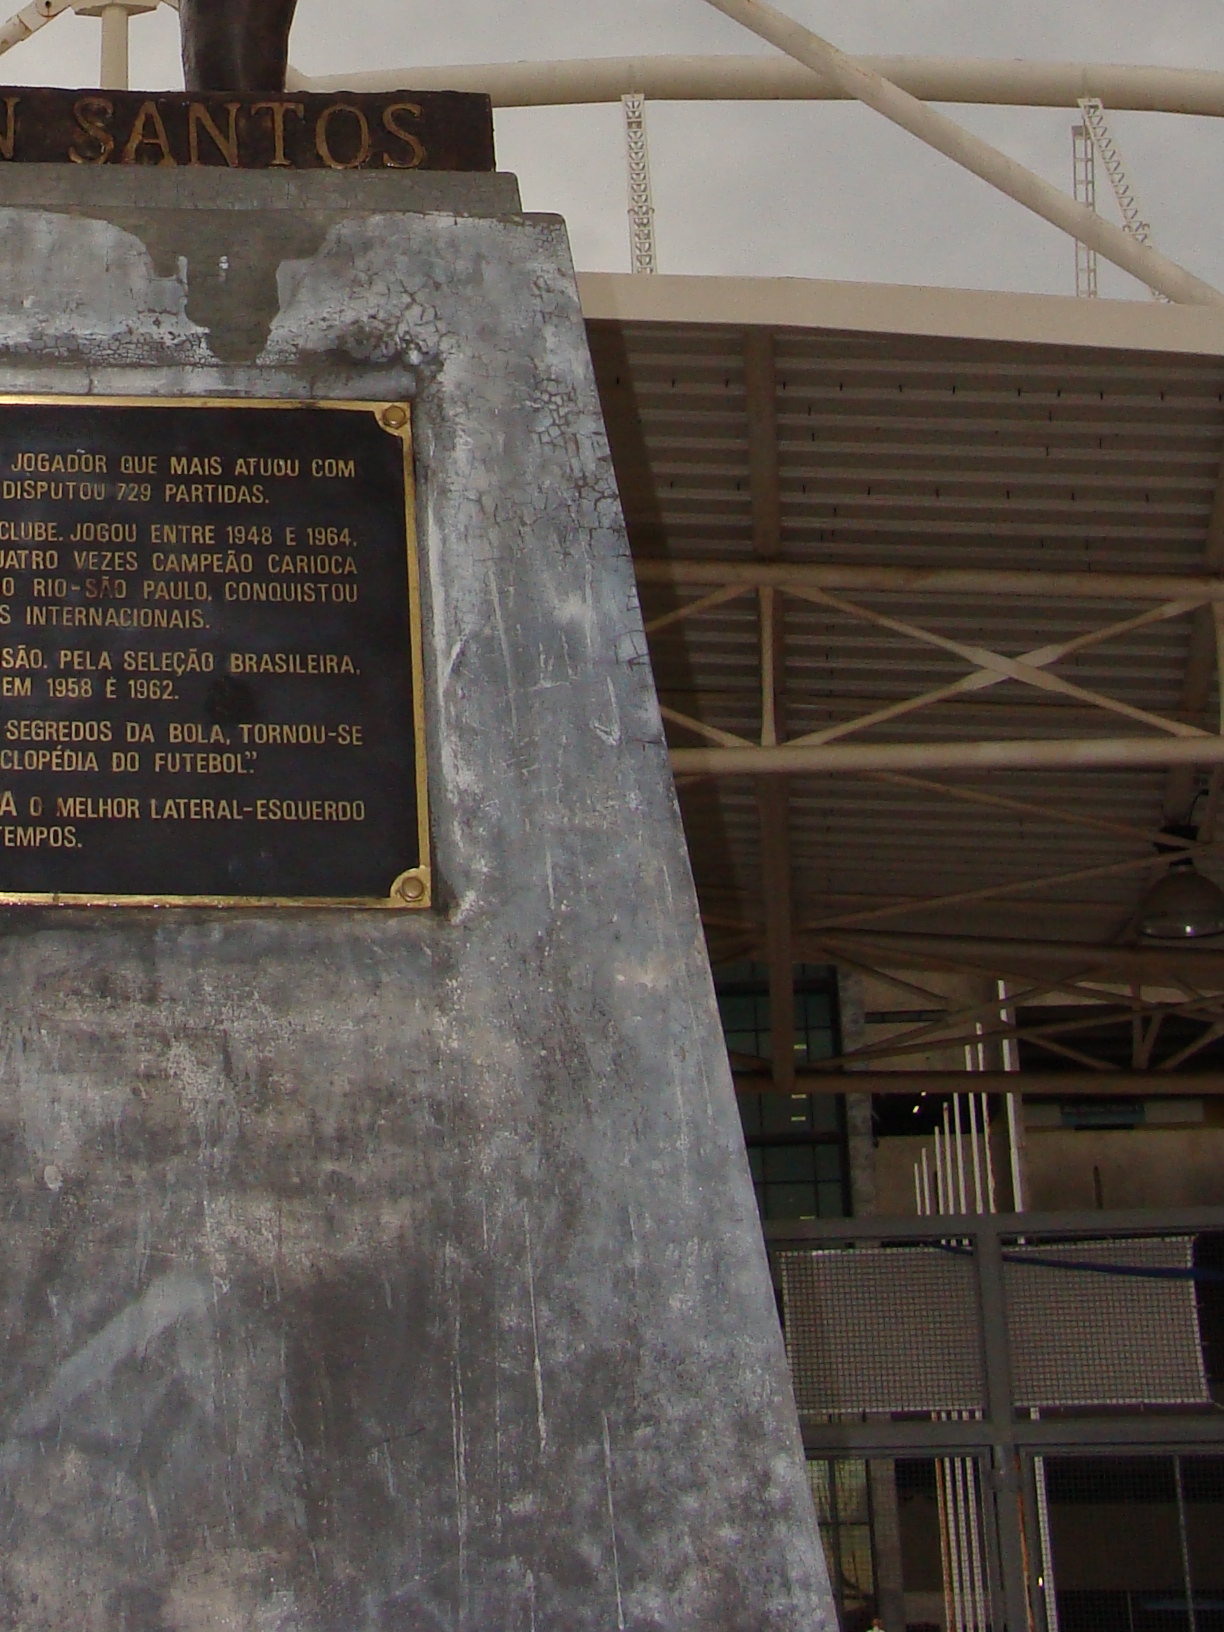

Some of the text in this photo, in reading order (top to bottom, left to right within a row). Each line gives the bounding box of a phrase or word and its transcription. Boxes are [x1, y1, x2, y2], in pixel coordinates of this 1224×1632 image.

[68, 97, 426, 168] SANTOS
[10, 452, 108, 474] JOGADOR
[119, 455, 158, 475] QUE
[170, 455, 223, 476] MAIS
[234, 457, 300, 477] ATUOU
[311, 458, 356, 478] COM
[2, 479, 106, 501] DISPUTOU
[116, 482, 152, 502] 729
[165, 483, 270, 504] PARTIDAS.
[69, 522, 137, 543] JOGOU
[150, 523, 216, 545] ENTRE
[225, 525, 273, 545] 1948
[285, 526, 297, 546] E
[73, 550, 138, 571] VEZES
[152, 549, 253, 574] CAMPEÃO
[267, 553, 358, 575] CARIOCA
[224, 581, 358, 603] CONQUISTOU
[25, 605, 211, 629] INTERNACIONAIS.
[59, 649, 113, 671] PELA
[123, 647, 214, 677] SELEÇÃO
[2, 676, 32, 697] EM
[46, 677, 93, 698] 1958
[105, 676, 117, 699] E
[127, 678, 180, 700] 1962.
[5, 719, 113, 742] SEGREDOS
[125, 721, 156, 744] DA
[168, 722, 231, 746] BOLA,
[237, 723, 363, 746] TORNOU-SE
[111, 751, 140, 773] DO
[29, 796, 43, 817] O
[55, 796, 141, 819] MELHOR
[149, 798, 365, 821] LATERAL-ESQUERDO
